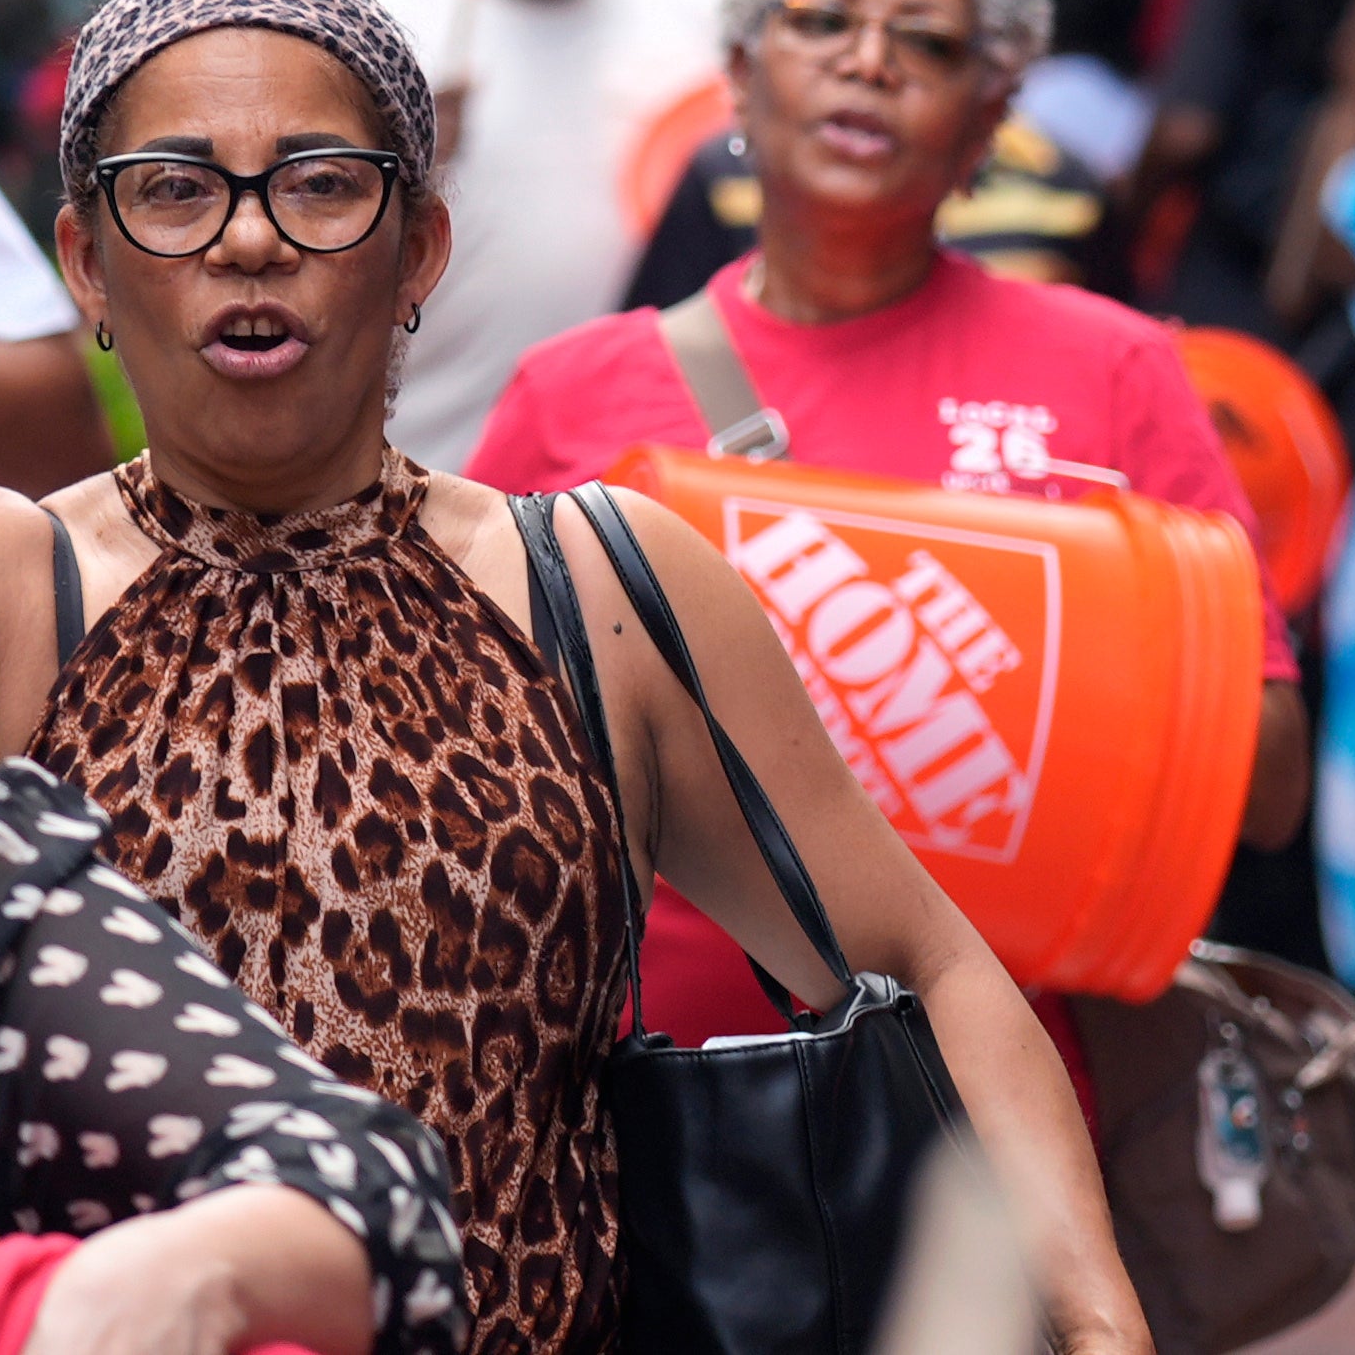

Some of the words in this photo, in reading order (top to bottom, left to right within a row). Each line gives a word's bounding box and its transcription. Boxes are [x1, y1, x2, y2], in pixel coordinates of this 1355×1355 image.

[948, 422, 1050, 480] 26
[733, 507, 1029, 846] HOME
[891, 548, 1024, 694] THE
